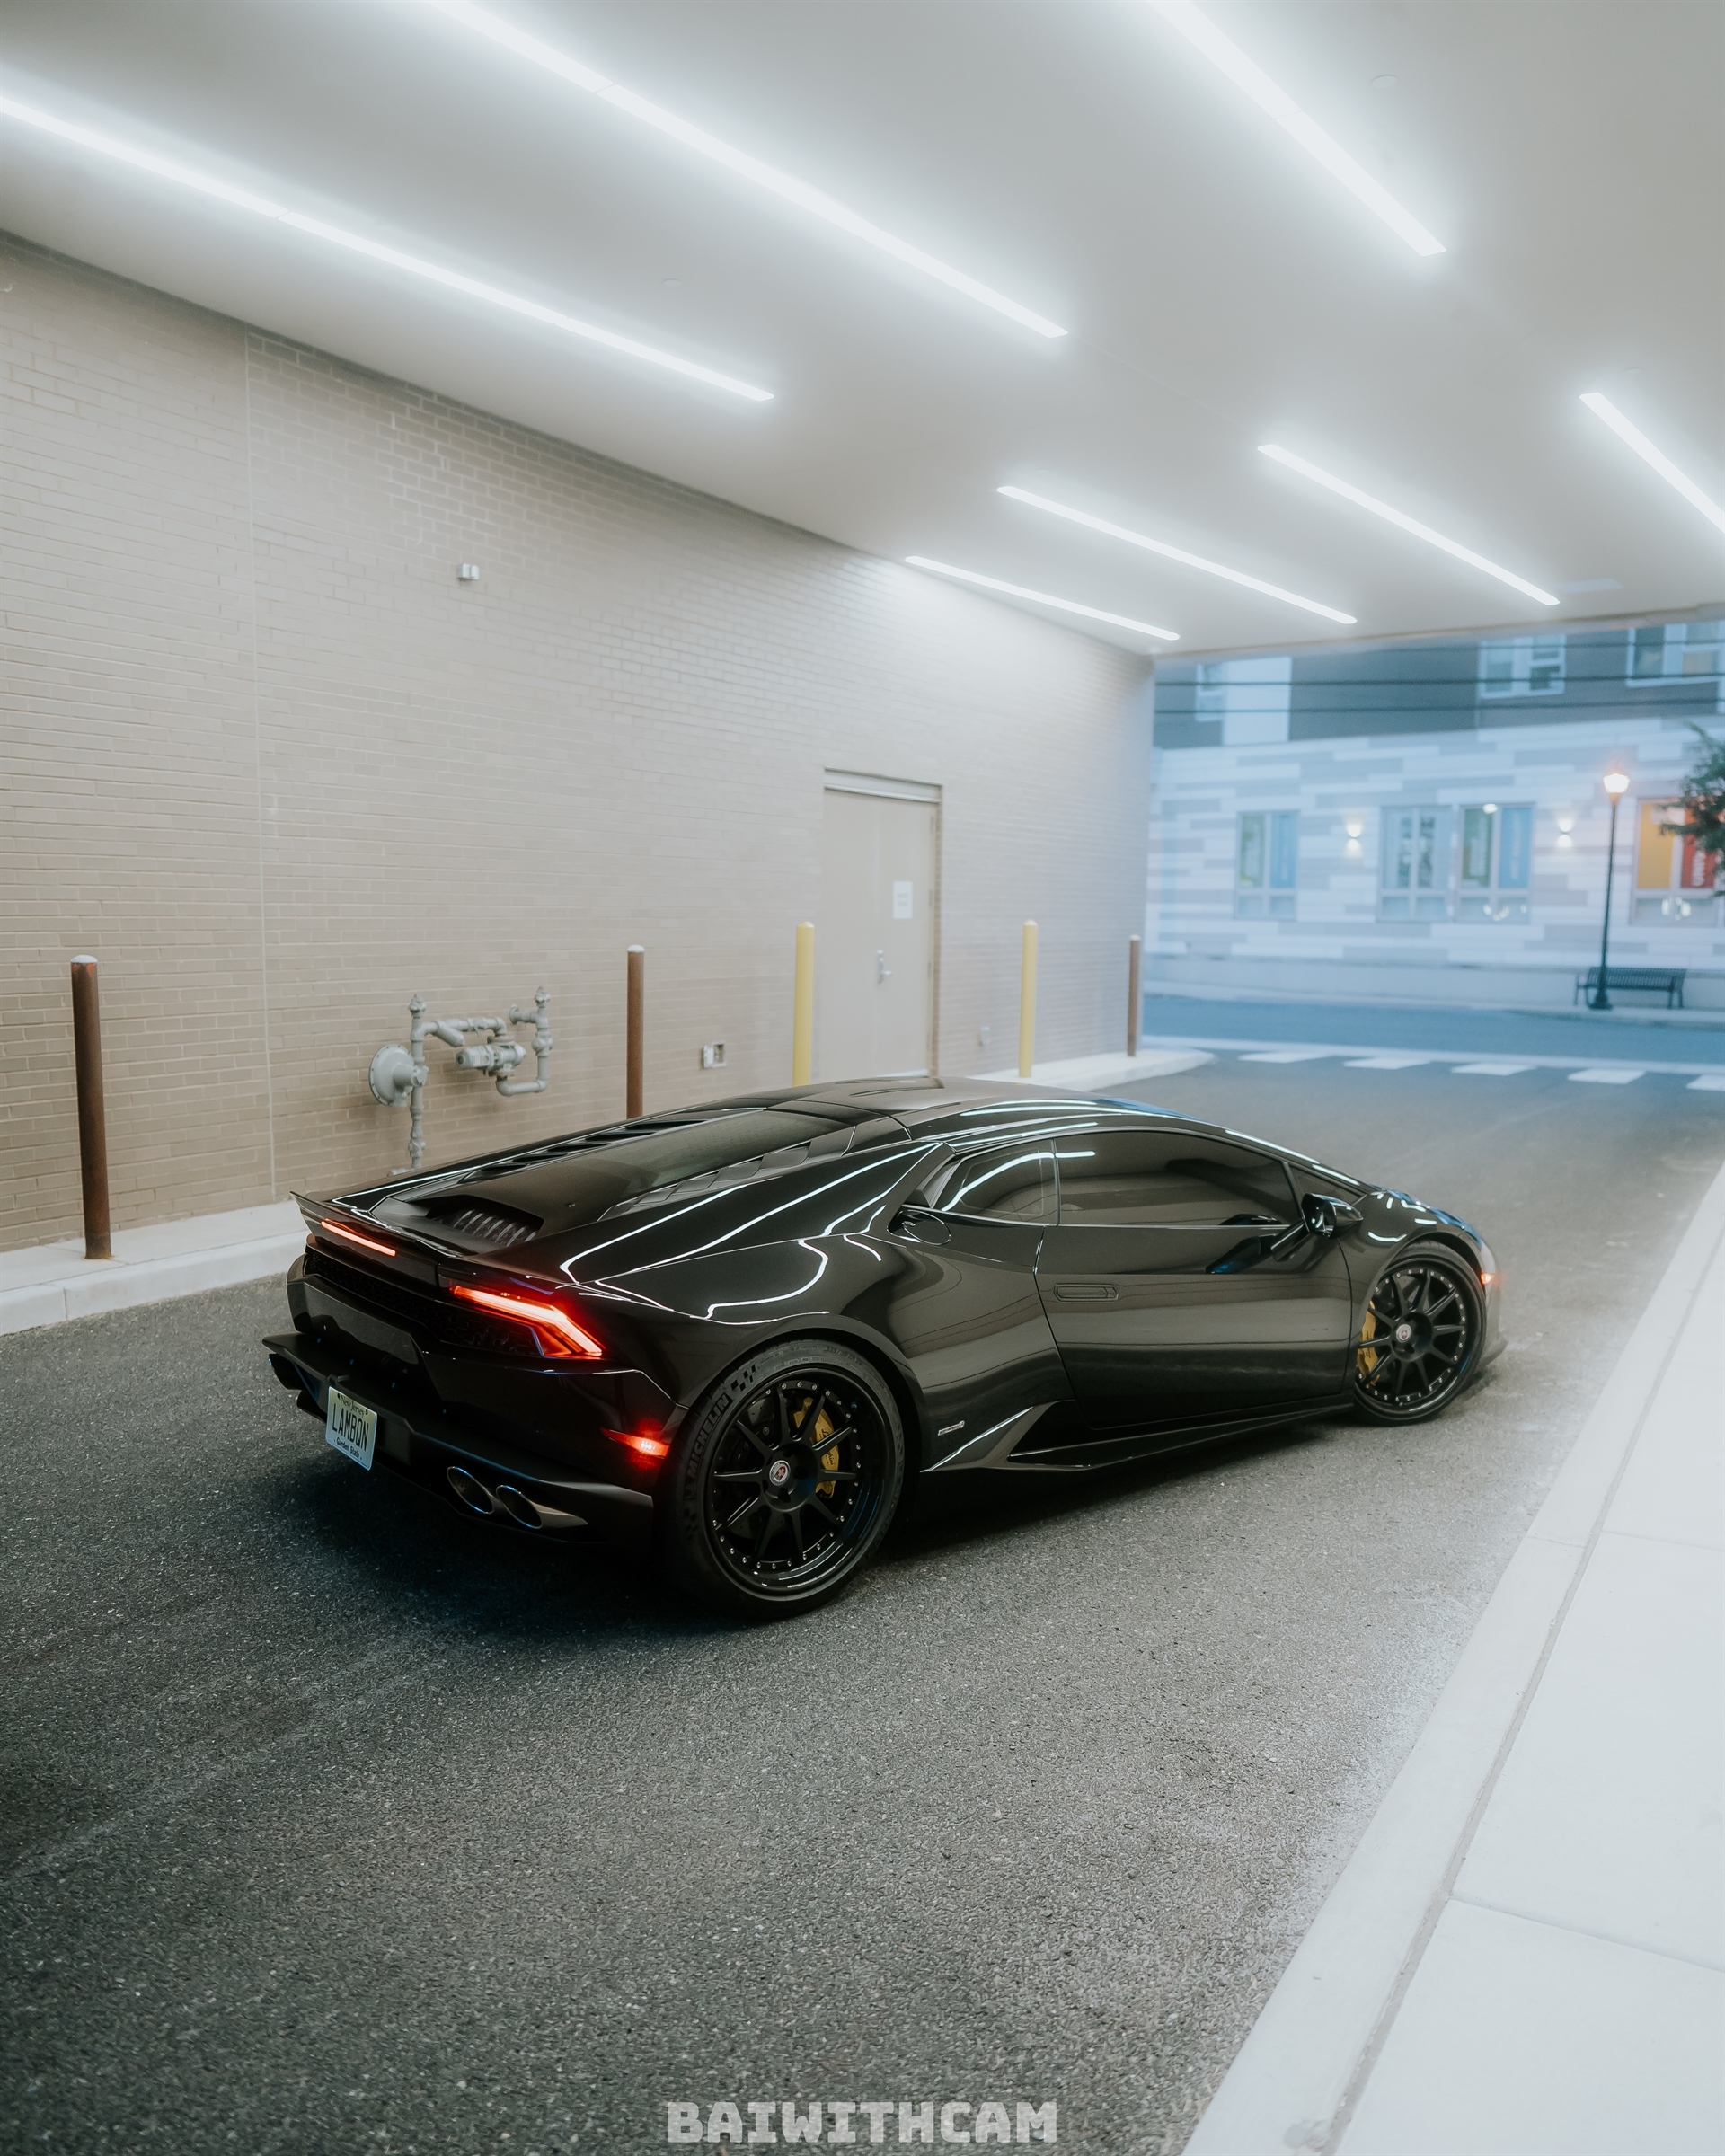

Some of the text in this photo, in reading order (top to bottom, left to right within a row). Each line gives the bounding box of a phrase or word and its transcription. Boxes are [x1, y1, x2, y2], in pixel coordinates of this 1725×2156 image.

[341, 1395, 365, 1418] New Jersey
[686, 1394, 729, 1476] MICHELIN
[337, 1437, 359, 1458] Garden State
